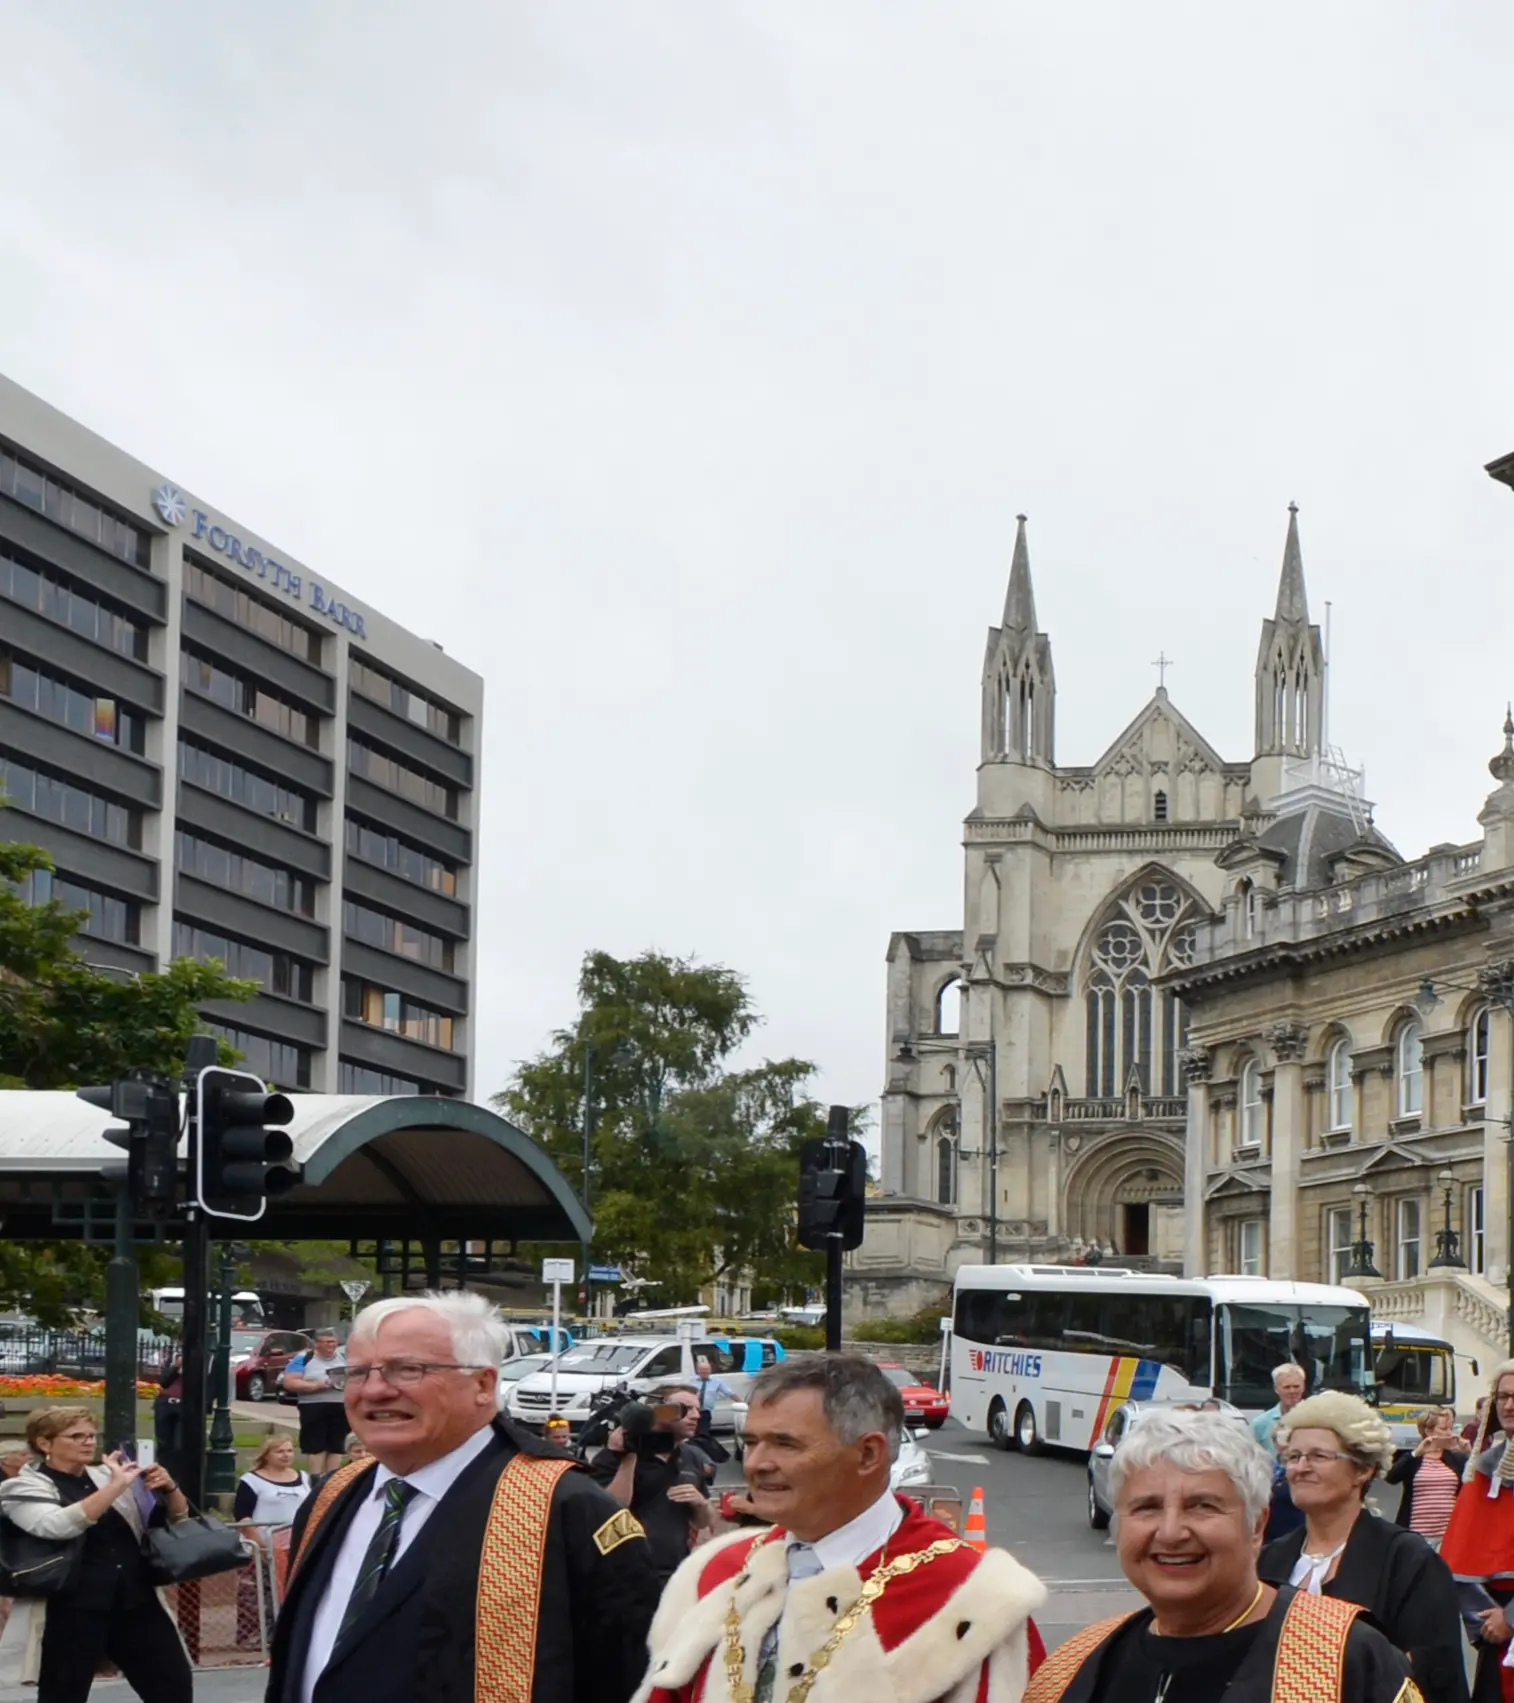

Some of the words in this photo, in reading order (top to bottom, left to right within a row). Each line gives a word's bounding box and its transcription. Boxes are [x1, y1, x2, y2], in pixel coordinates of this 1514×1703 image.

[192, 508, 302, 600] FORSYTH
[309, 581, 367, 641] BARR
[983, 1350, 1042, 1378] RITCHIES
